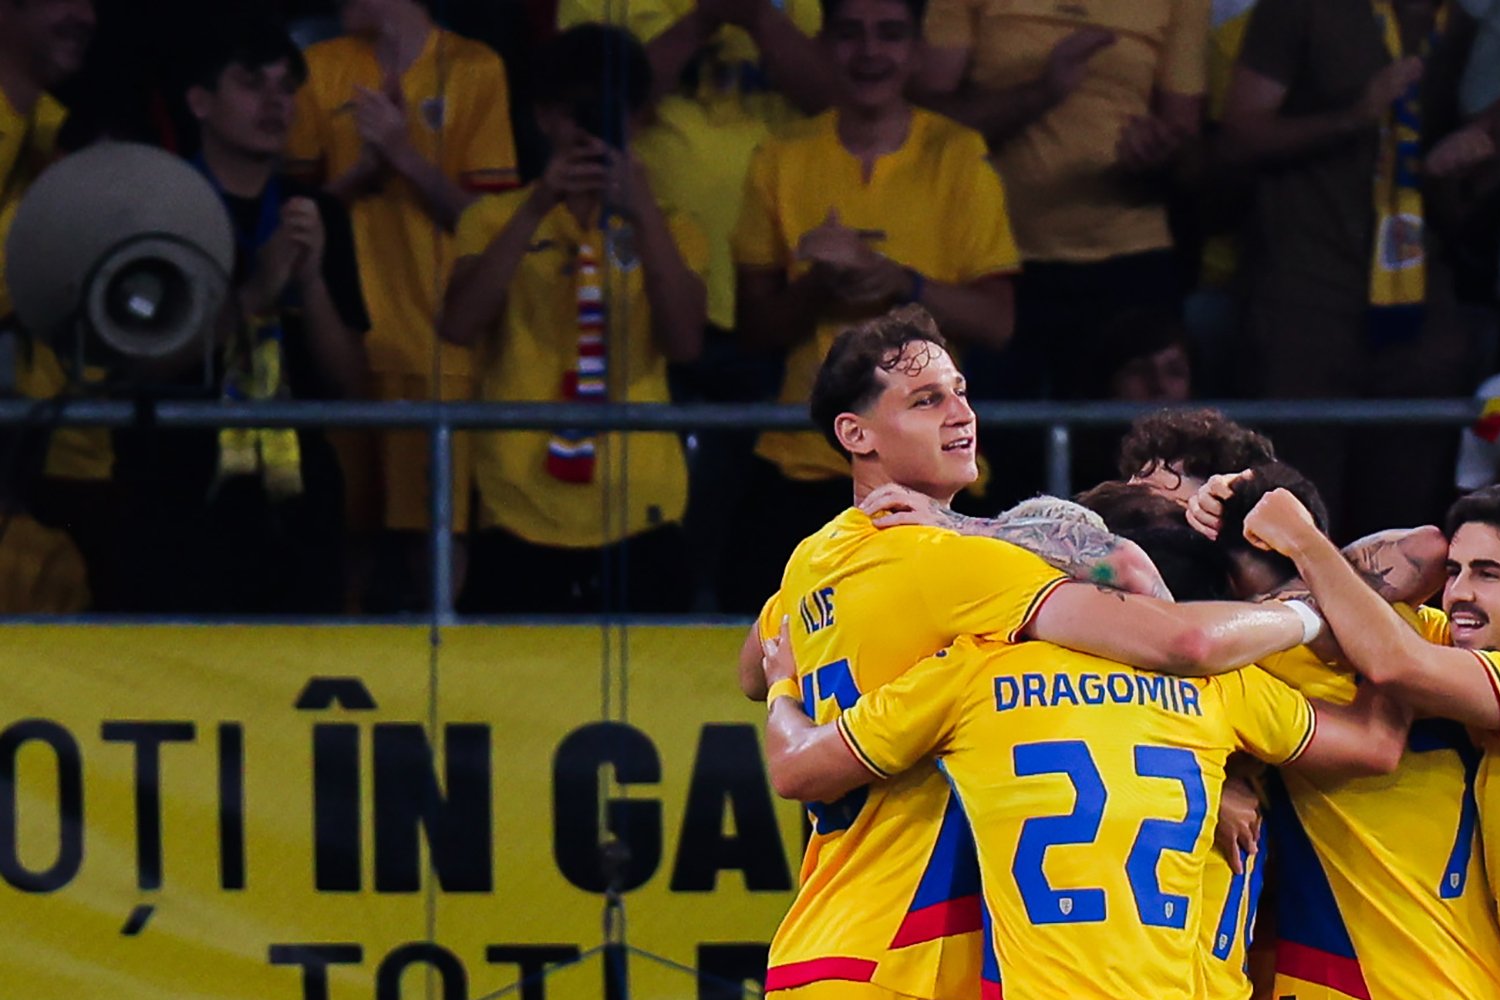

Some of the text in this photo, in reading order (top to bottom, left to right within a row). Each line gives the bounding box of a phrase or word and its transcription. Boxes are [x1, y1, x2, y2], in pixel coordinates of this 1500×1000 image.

[800, 586, 835, 635] ILIE
[993, 672, 1204, 717] DRAGOMIR
[294, 677, 494, 892] ÎN
[1010, 739, 1208, 930] 22
